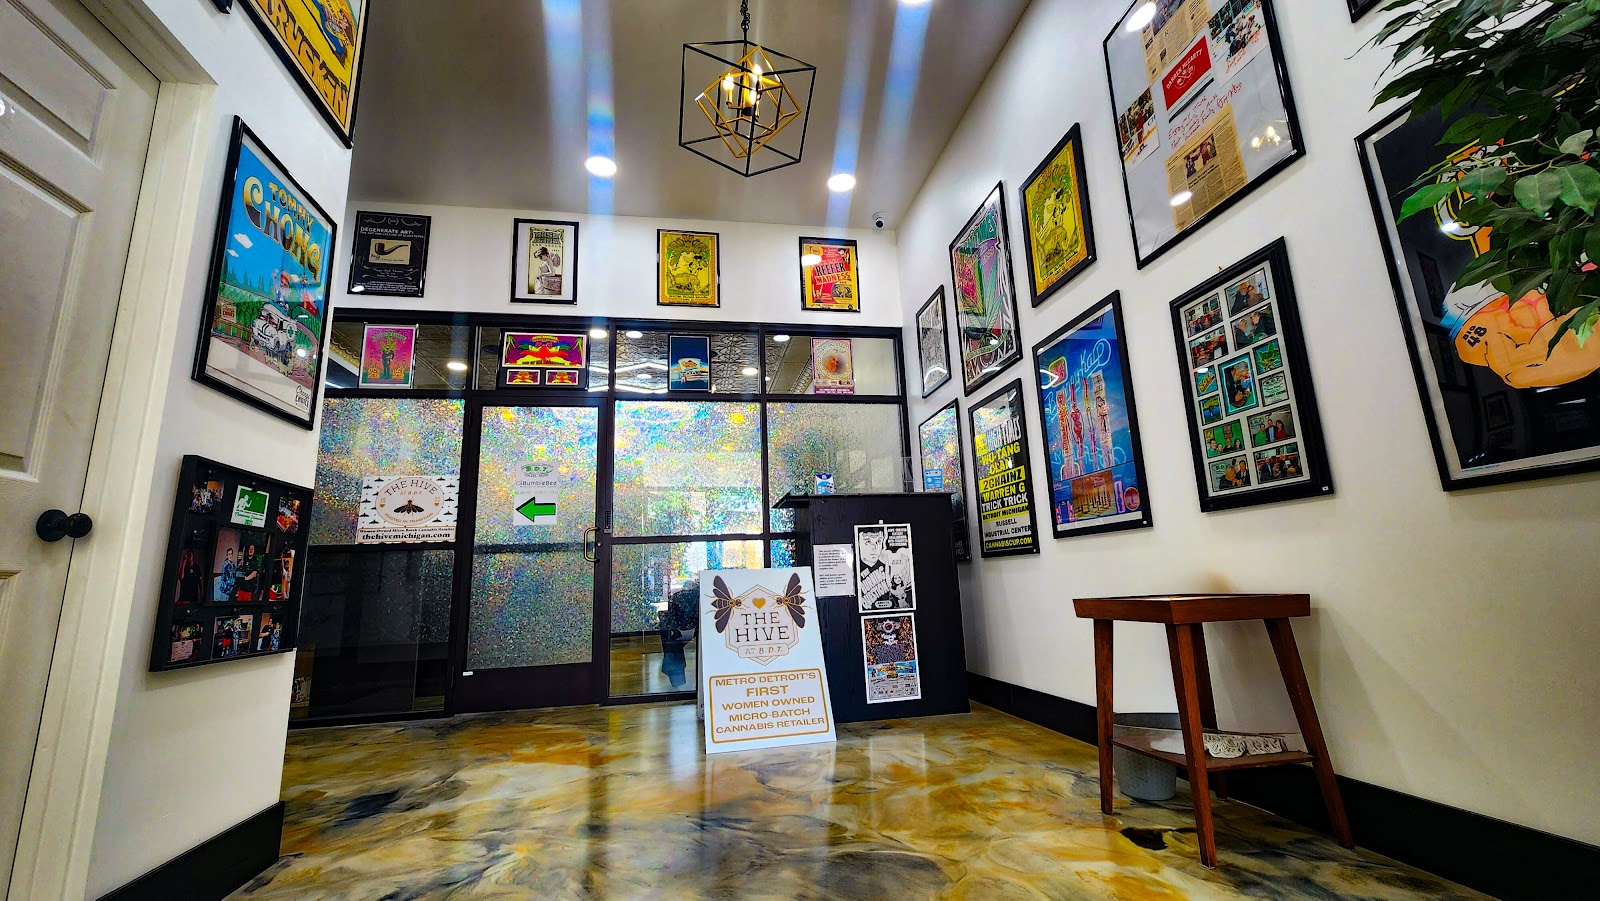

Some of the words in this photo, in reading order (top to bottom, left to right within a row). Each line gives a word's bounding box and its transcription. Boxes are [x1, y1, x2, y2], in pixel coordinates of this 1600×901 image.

[268, 181, 315, 234] TOMMY
[243, 175, 321, 283] CHONG
[360, 226, 399, 234] DEGENERATE
[816, 262, 846, 276] REEFER
[815, 271, 851, 284] MADNESS
[1003, 415, 1022, 446] TIMES
[981, 441, 1021, 466] WU-TANG
[384, 480, 408, 496] THE
[410, 479, 438, 495] HIVE
[982, 484, 1016, 503] WARREN
[1018, 482, 1026, 493] G
[981, 501, 1003, 514] TRICK
[1003, 492, 1028, 507] TRICK
[982, 511, 1002, 521] DETROIT
[1001, 505, 1030, 517] MICHIGAN
[995, 518, 1018, 528] RUSSELL
[362, 532, 451, 540] thehivemichigan.com
[985, 528, 1010, 538] INDUSTRIAL
[1011, 524, 1032, 534] CENTER
[985, 536, 1033, 549] CANNABISCUP.COM
[740, 611, 781, 626] THE
[734, 625, 790, 643] HIVE
[744, 647, 756, 655] AT
[715, 676, 757, 687] METRO
[759, 671, 817, 684] DETROIT'S
[746, 685, 789, 698] FIRST
[721, 700, 770, 711] WOMEN
[771, 696, 816, 707] OWNED
[729, 707, 811, 722] MICRO-BATCH
[715, 721, 775, 734] CANNABIS
[776, 717, 825, 729] RETAILER
